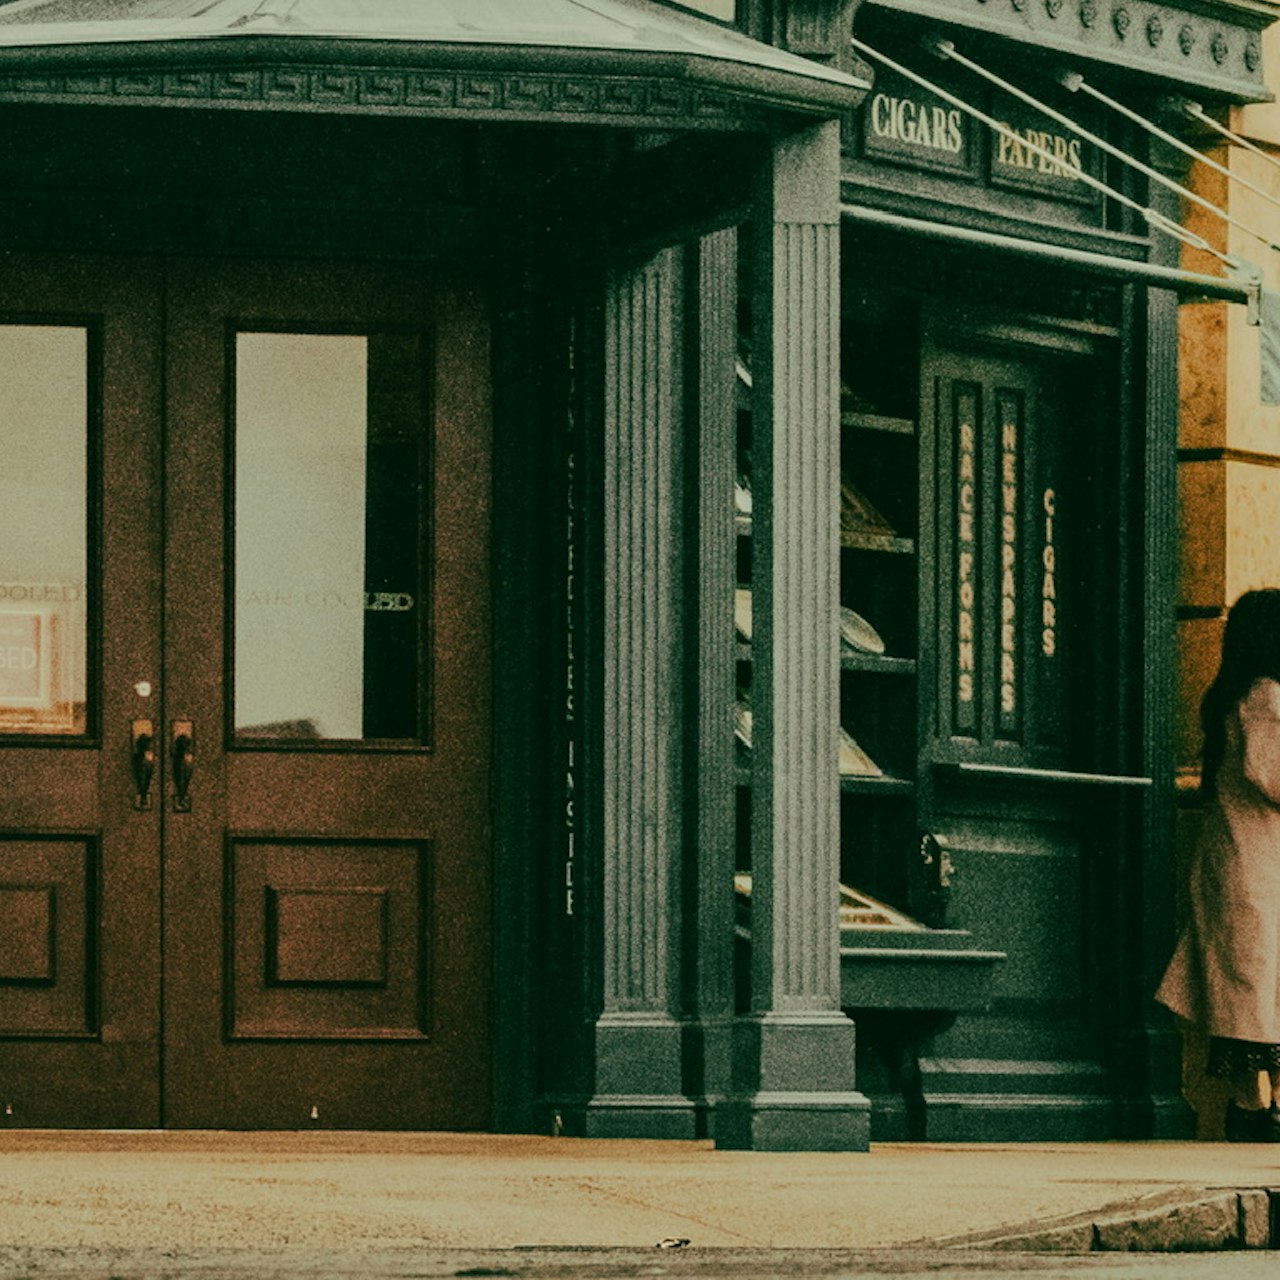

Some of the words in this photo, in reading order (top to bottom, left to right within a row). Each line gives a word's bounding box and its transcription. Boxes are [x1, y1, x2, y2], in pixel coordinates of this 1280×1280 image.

[871, 92, 963, 154] CIGARS
[997, 125, 1082, 180] PAPERS
[959, 423, 974, 542] RACE
[959, 551, 974, 704] FORMS
[1000, 423, 1016, 713] NEWSPAPERS
[1042, 487, 1056, 657] CIGARS
